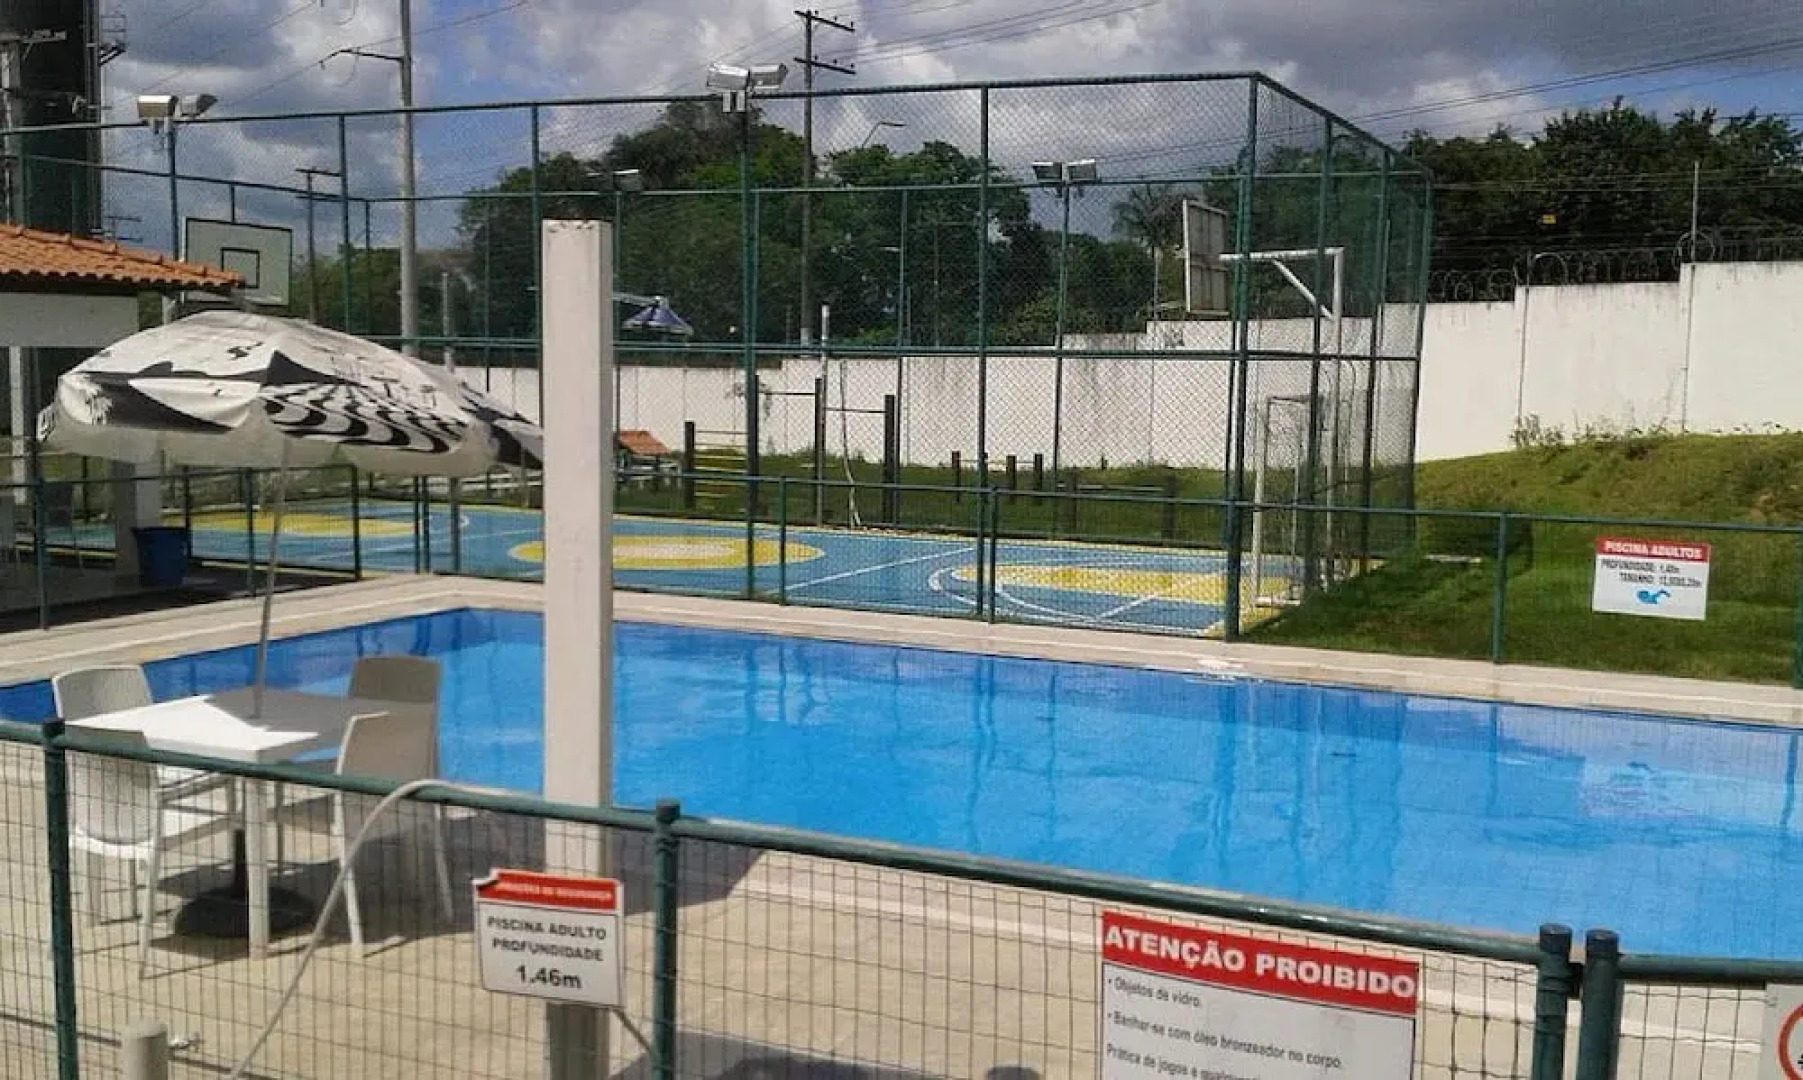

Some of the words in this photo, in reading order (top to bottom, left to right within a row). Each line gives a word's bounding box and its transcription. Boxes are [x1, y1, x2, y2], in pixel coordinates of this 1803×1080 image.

[1604, 540, 1649, 555] PISCINA
[1652, 544, 1703, 560] ADULTOS
[487, 916, 544, 933] PISCINA
[548, 922, 607, 940] ADULTO
[492, 937, 605, 962] PROFUNDIDADE
[1105, 925, 1246, 972] ATENÇÃO
[1255, 952, 1416, 998] PROIBIDO
[516, 965, 582, 989] 1.46m
[1113, 976, 1153, 998] Objetos
[1156, 988, 1169, 1001] de
[1168, 1026, 1191, 1042] com
[1193, 1028, 1218, 1047] óleo
[1220, 1033, 1285, 1058] bronzeador
[1288, 1050, 1304, 1062] no
[1106, 1042, 1141, 1066] Prática
[1143, 1053, 1156, 1068] de
[1158, 1058, 1189, 1076] jogos
